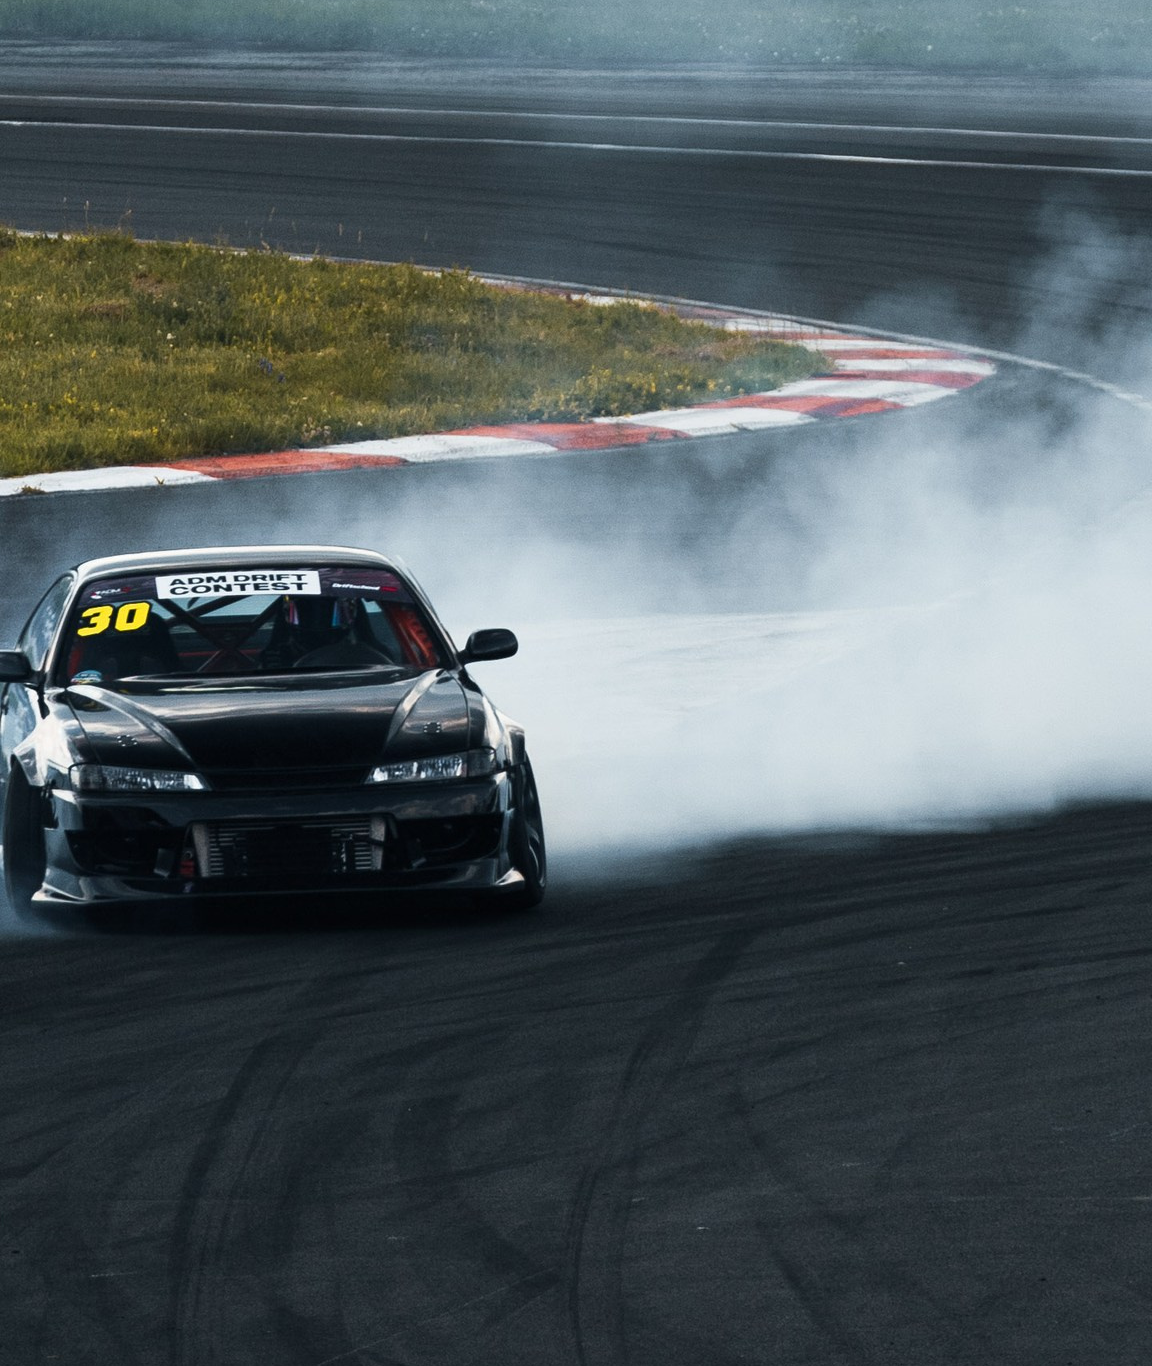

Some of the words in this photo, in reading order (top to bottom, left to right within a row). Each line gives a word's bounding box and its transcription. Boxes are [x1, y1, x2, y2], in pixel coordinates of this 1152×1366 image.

[170, 575, 227, 586] ADM
[233, 573, 307, 583] DRIFT
[169, 582, 308, 596] CONTEST
[77, 602, 150, 637] 30
